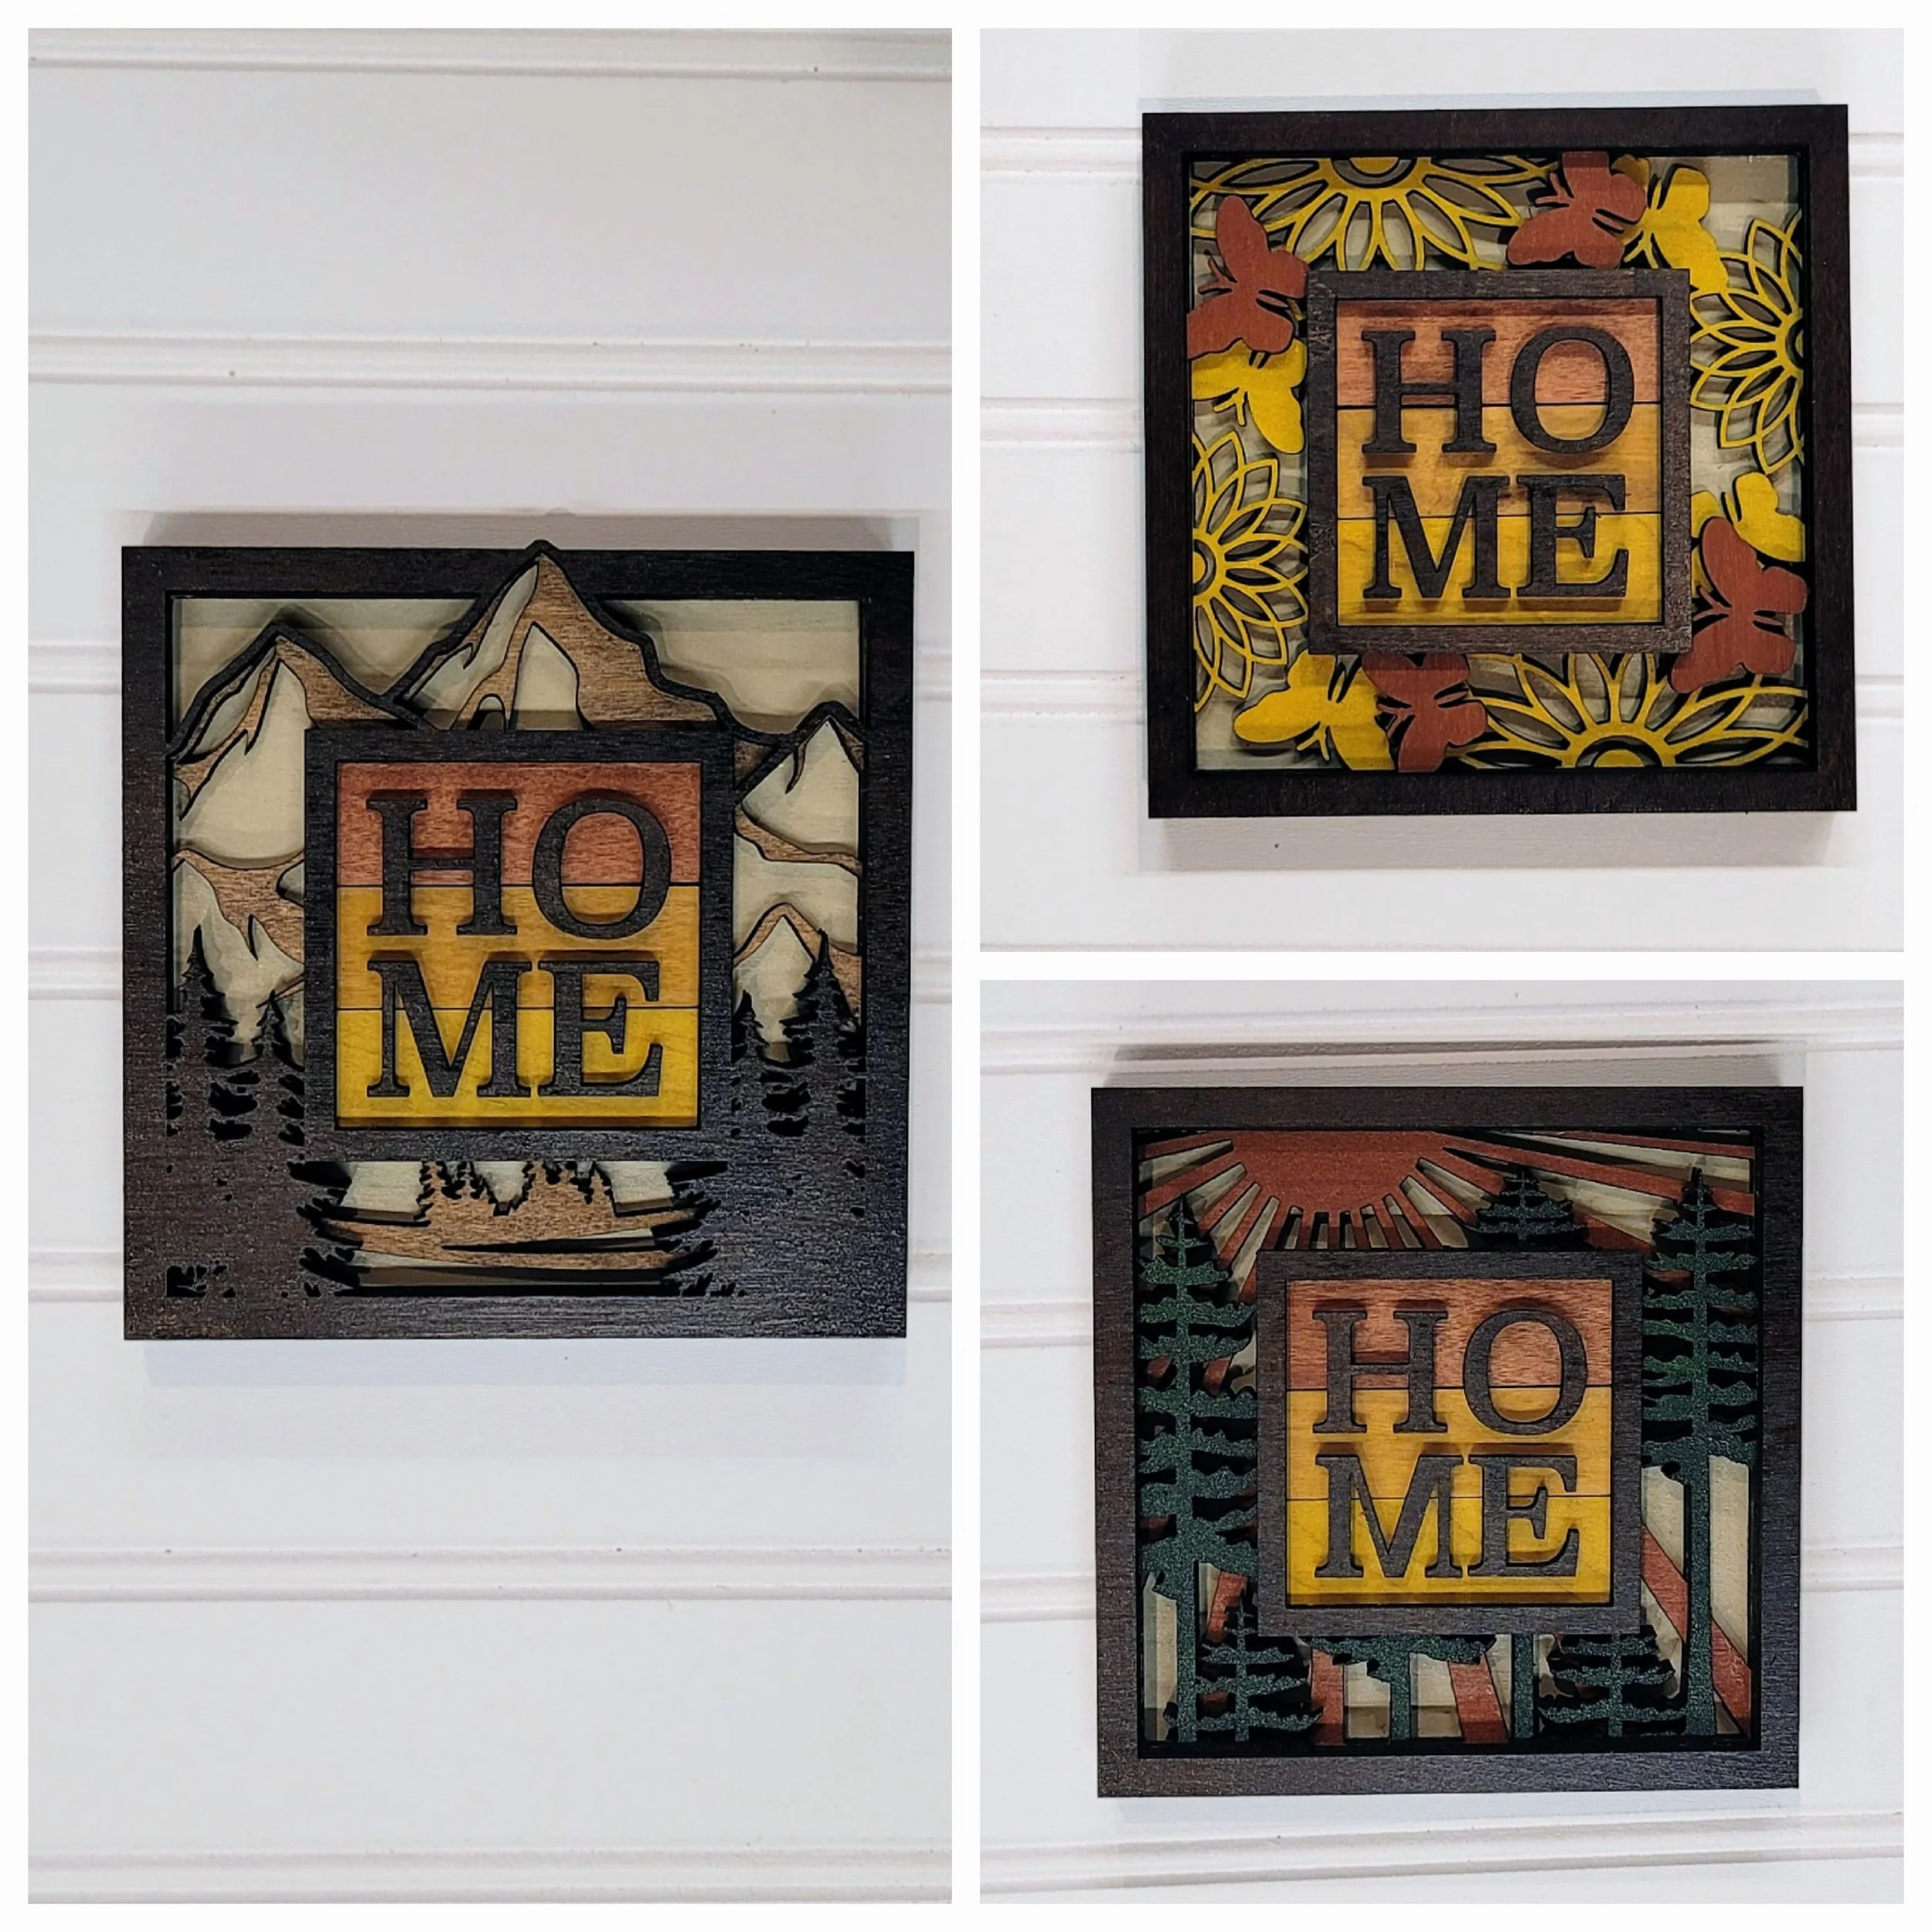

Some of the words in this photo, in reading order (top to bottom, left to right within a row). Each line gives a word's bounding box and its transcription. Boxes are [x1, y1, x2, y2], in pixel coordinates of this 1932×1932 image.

[1362, 325, 1635, 454] HO
[1362, 474, 1629, 599] ME
[366, 797, 672, 940] HO
[366, 959, 664, 1097] ME
[1311, 1309, 1587, 1435] HO
[1315, 1454, 1580, 1578] ME
